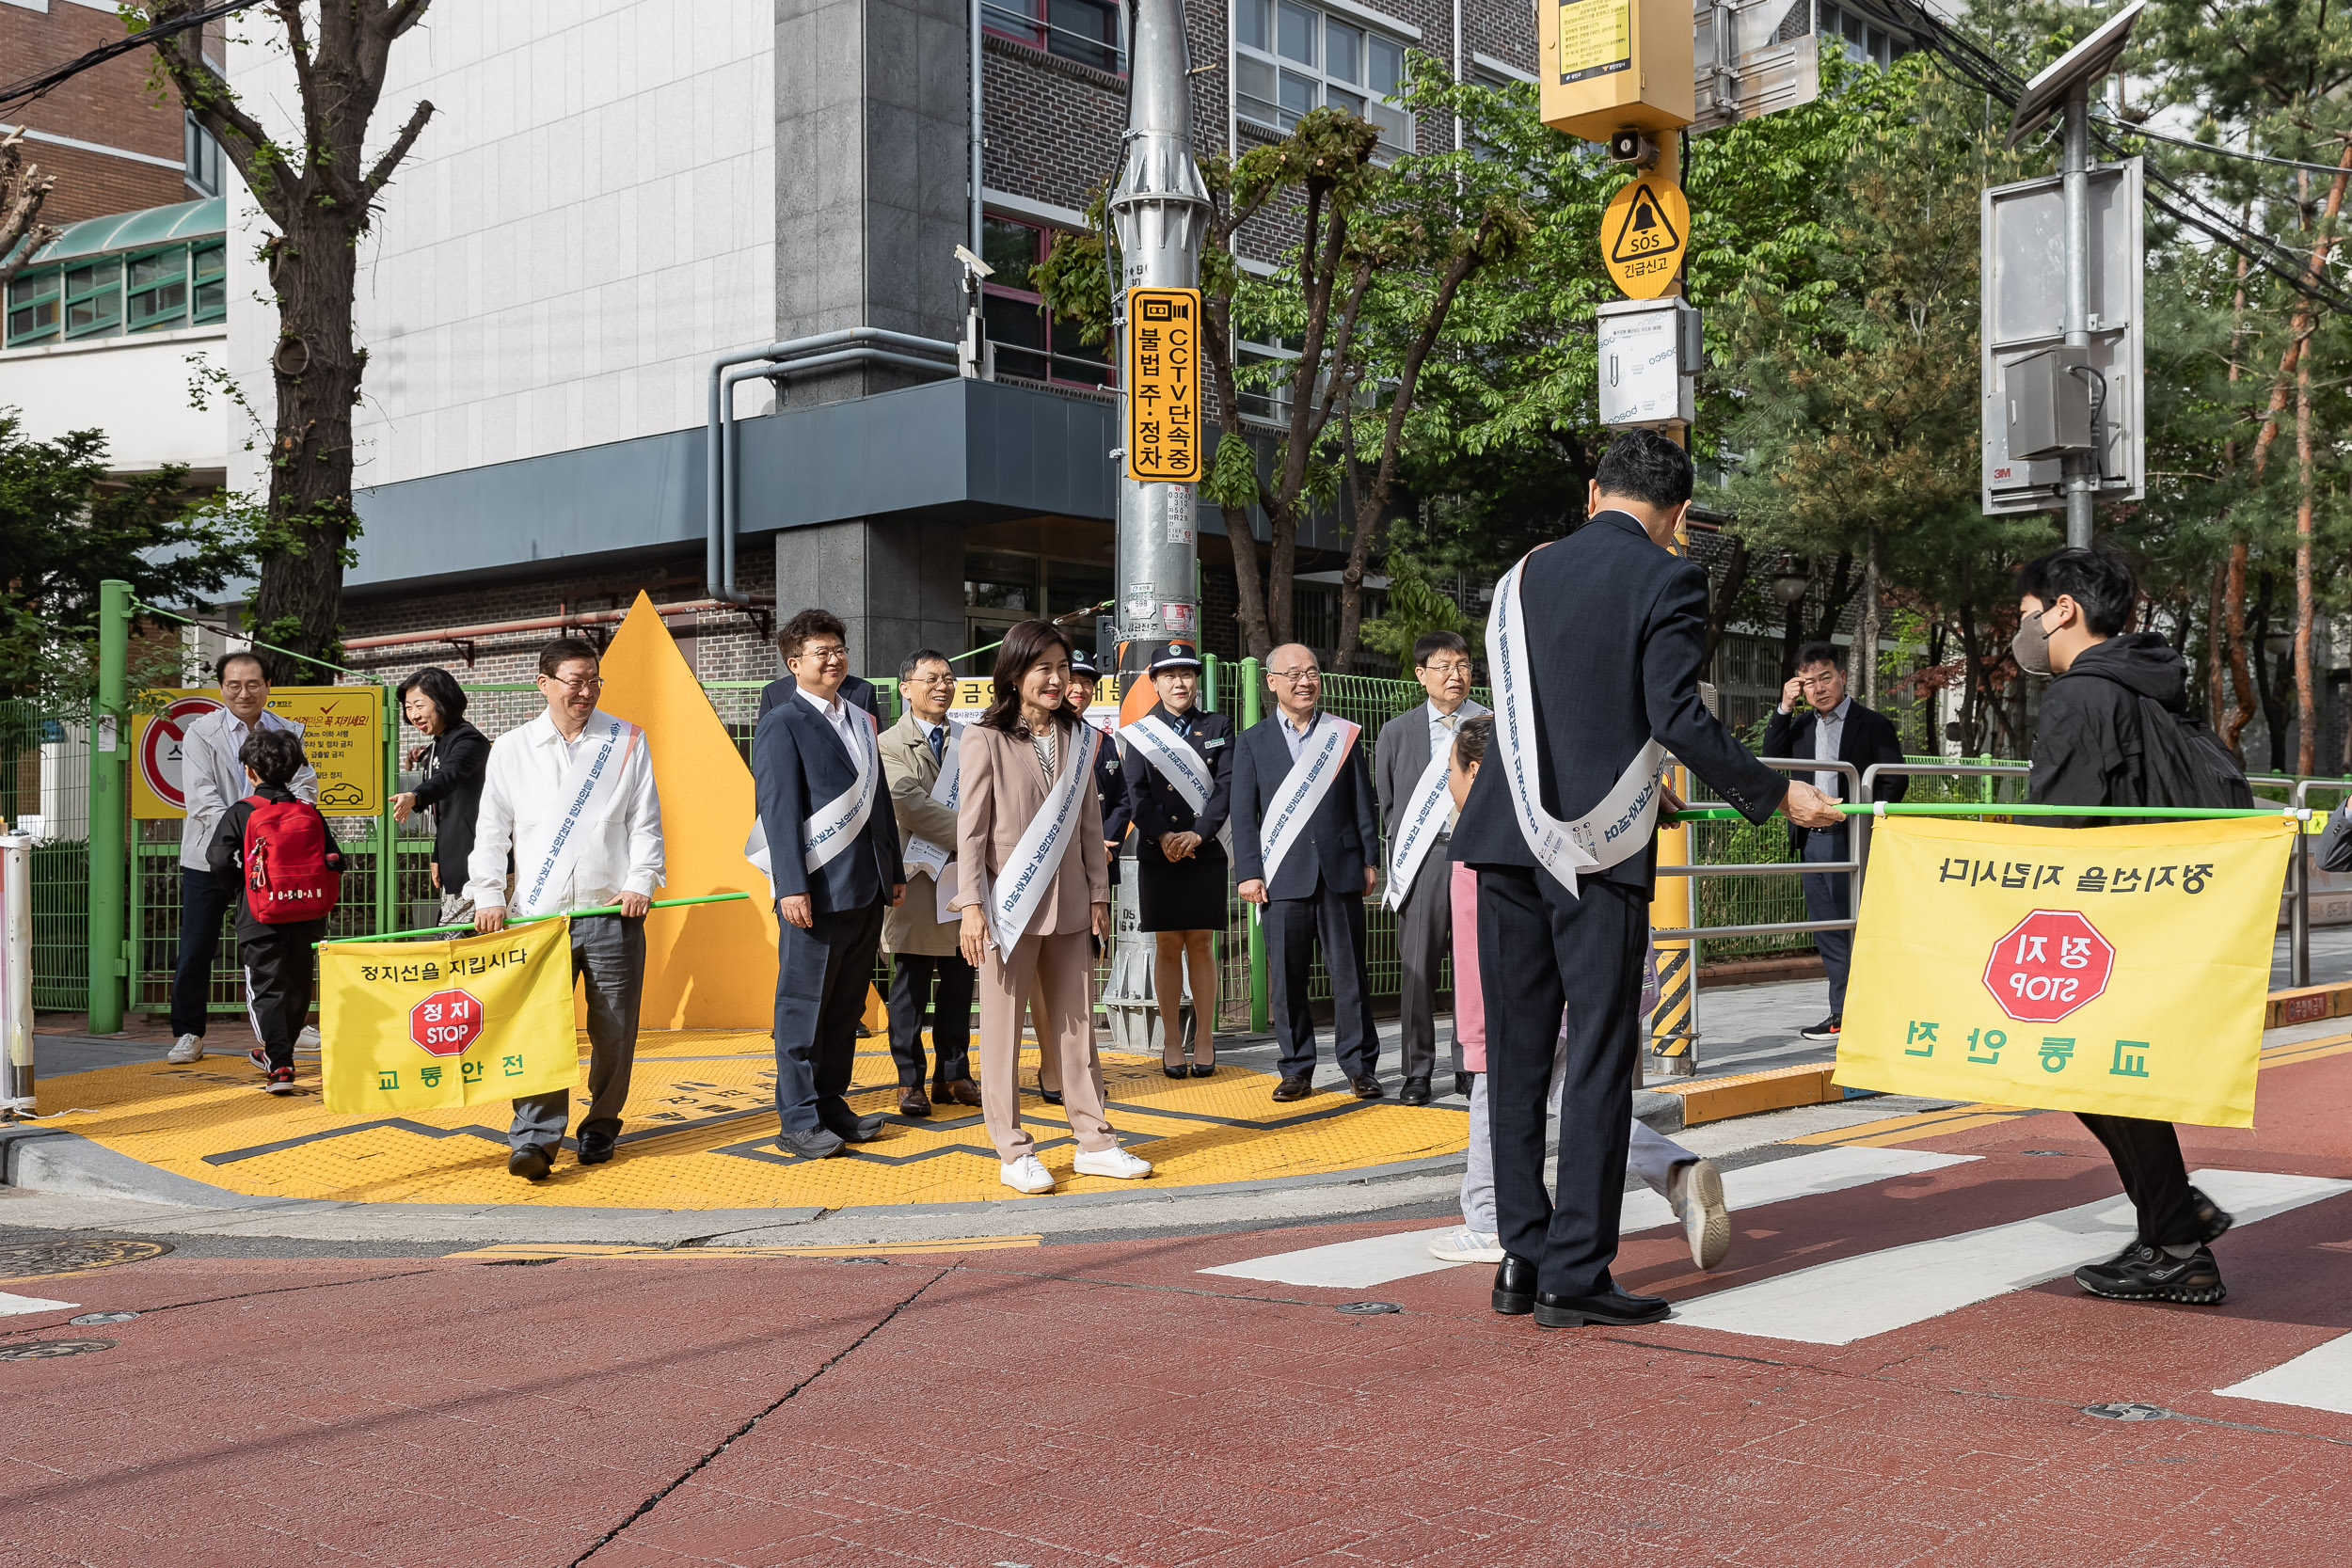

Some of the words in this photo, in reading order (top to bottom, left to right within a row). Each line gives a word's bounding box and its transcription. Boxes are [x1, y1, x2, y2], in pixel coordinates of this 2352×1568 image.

[1630, 233, 1661, 252] SOS
[1624, 258, 1668, 278] 긴급신고
[1138, 327, 1162, 377] 불법
[1994, 467, 2010, 479] 3M
[334, 715, 369, 726] 지키세요!
[589, 744, 612, 780] 아이들의
[1307, 751, 1329, 784] 아이들의
[1506, 692, 1520, 756] 안전하게
[1514, 755, 1539, 835] 지켜주세요
[835, 798, 865, 831] 안전하게
[1418, 790, 1440, 826] 안전하게
[1604, 781, 1654, 844] 지켜주세요
[549, 817, 575, 858] 안전하게
[1033, 823, 1061, 864] 안전하게
[1267, 814, 1289, 847] 안전하게
[1395, 825, 1421, 869] 지켜주세요
[527, 857, 555, 906] 지켜주세요
[1001, 862, 1039, 912] 지켜주세요
[360, 962, 440, 983] 정지선을
[449, 948, 528, 976] 지킵시다
[426, 1024, 469, 1044] STOP
